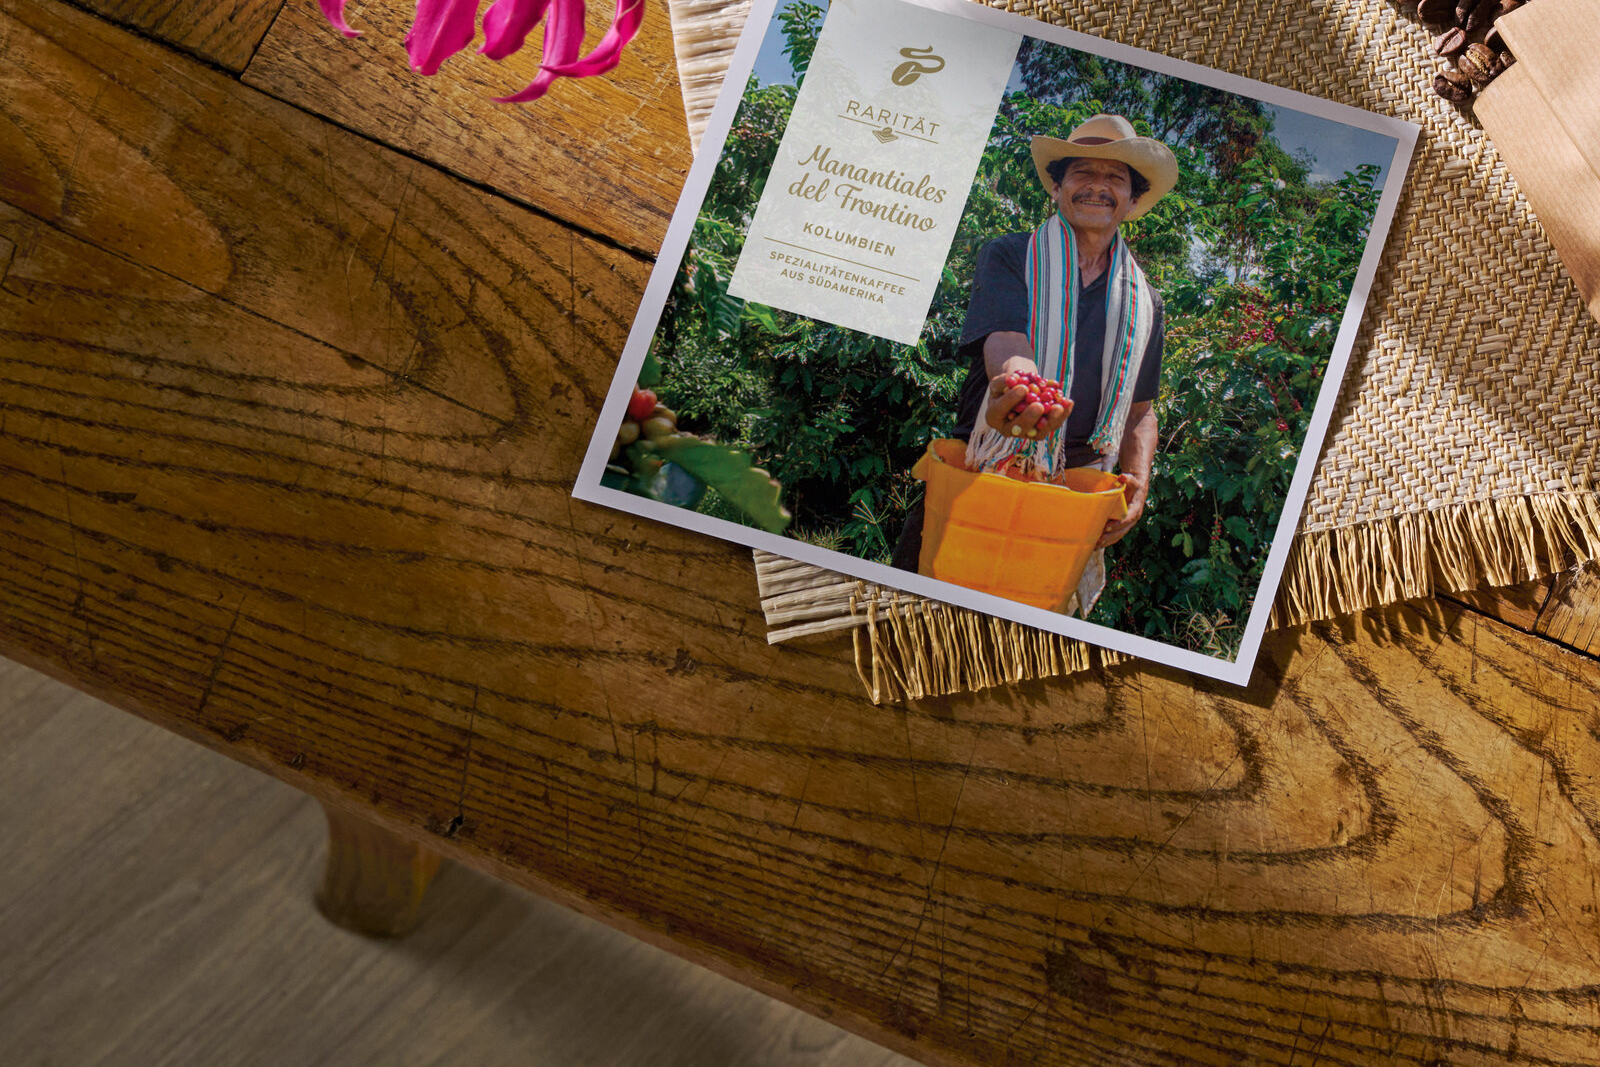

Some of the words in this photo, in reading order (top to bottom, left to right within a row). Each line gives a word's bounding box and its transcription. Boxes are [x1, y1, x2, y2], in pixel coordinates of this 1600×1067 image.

[846, 100, 940, 136] RARITÄT
[797, 145, 947, 204] Manantiales
[788, 173, 830, 203] del
[834, 183, 937, 232] Frontino
[803, 222, 896, 257] KOLUMBIEN
[769, 251, 906, 296] SPEZIALITÄTENKAFFEE
[780, 268, 804, 282] AUS
[808, 272, 885, 304] SÜDAMERIKA
